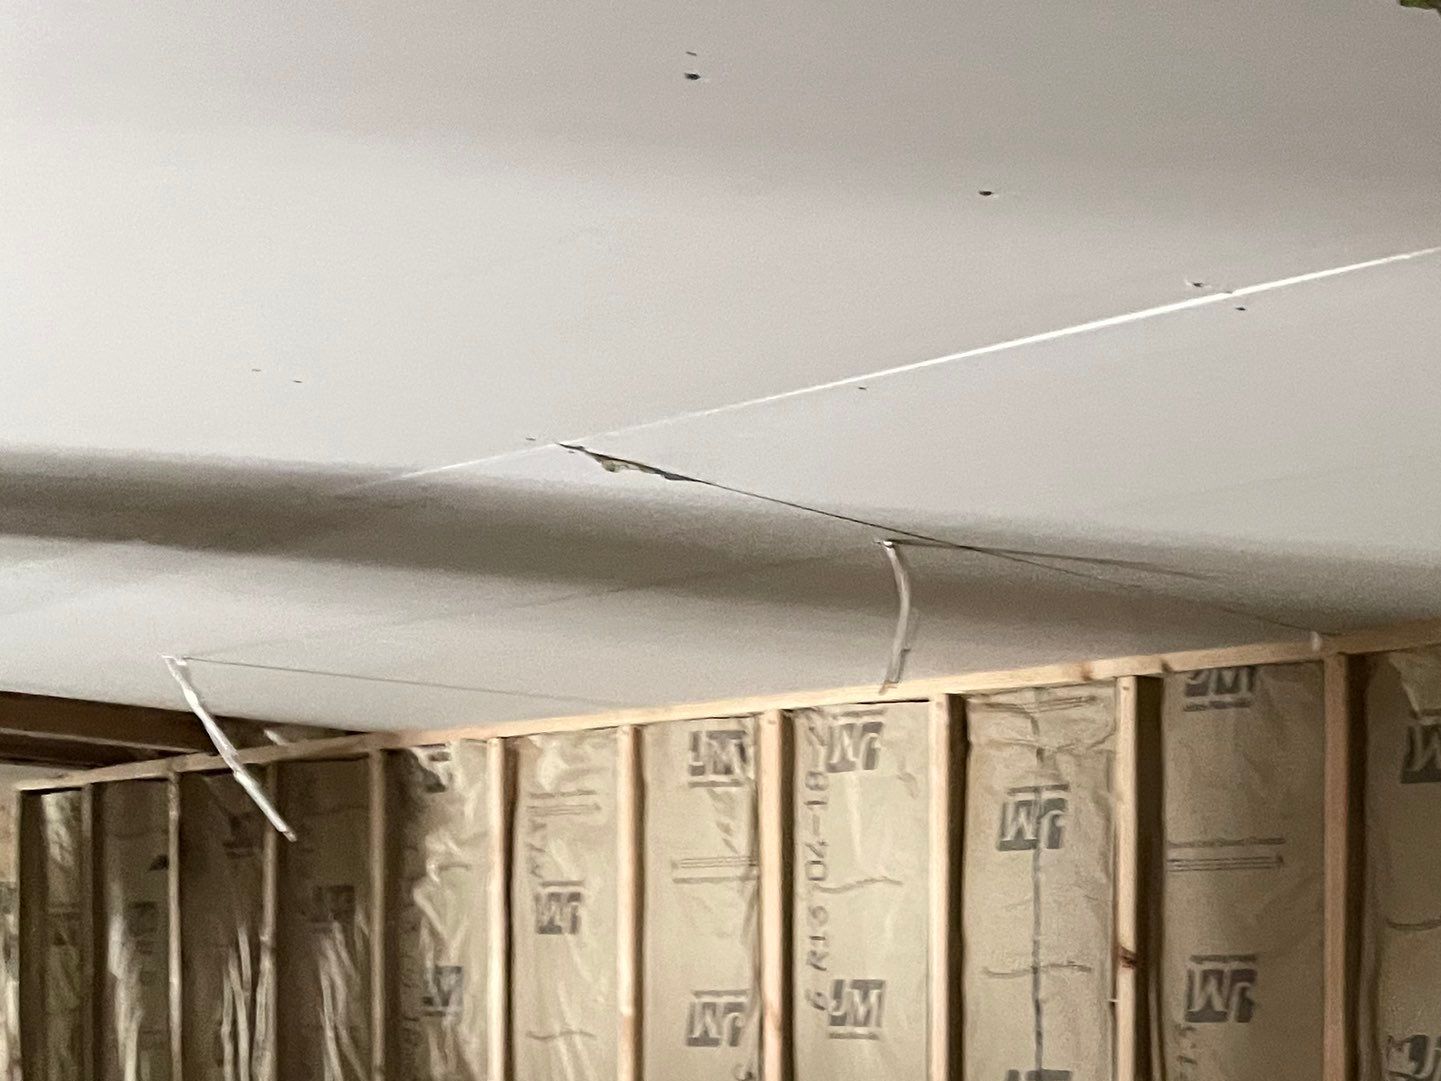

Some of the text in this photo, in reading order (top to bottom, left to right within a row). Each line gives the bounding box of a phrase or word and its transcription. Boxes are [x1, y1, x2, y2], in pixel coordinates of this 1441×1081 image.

[827, 721, 884, 773] JM
[997, 798, 1069, 851] JM
[828, 979, 886, 1028] JM
[1185, 969, 1257, 1023] JM
[686, 1000, 748, 1048] JM
